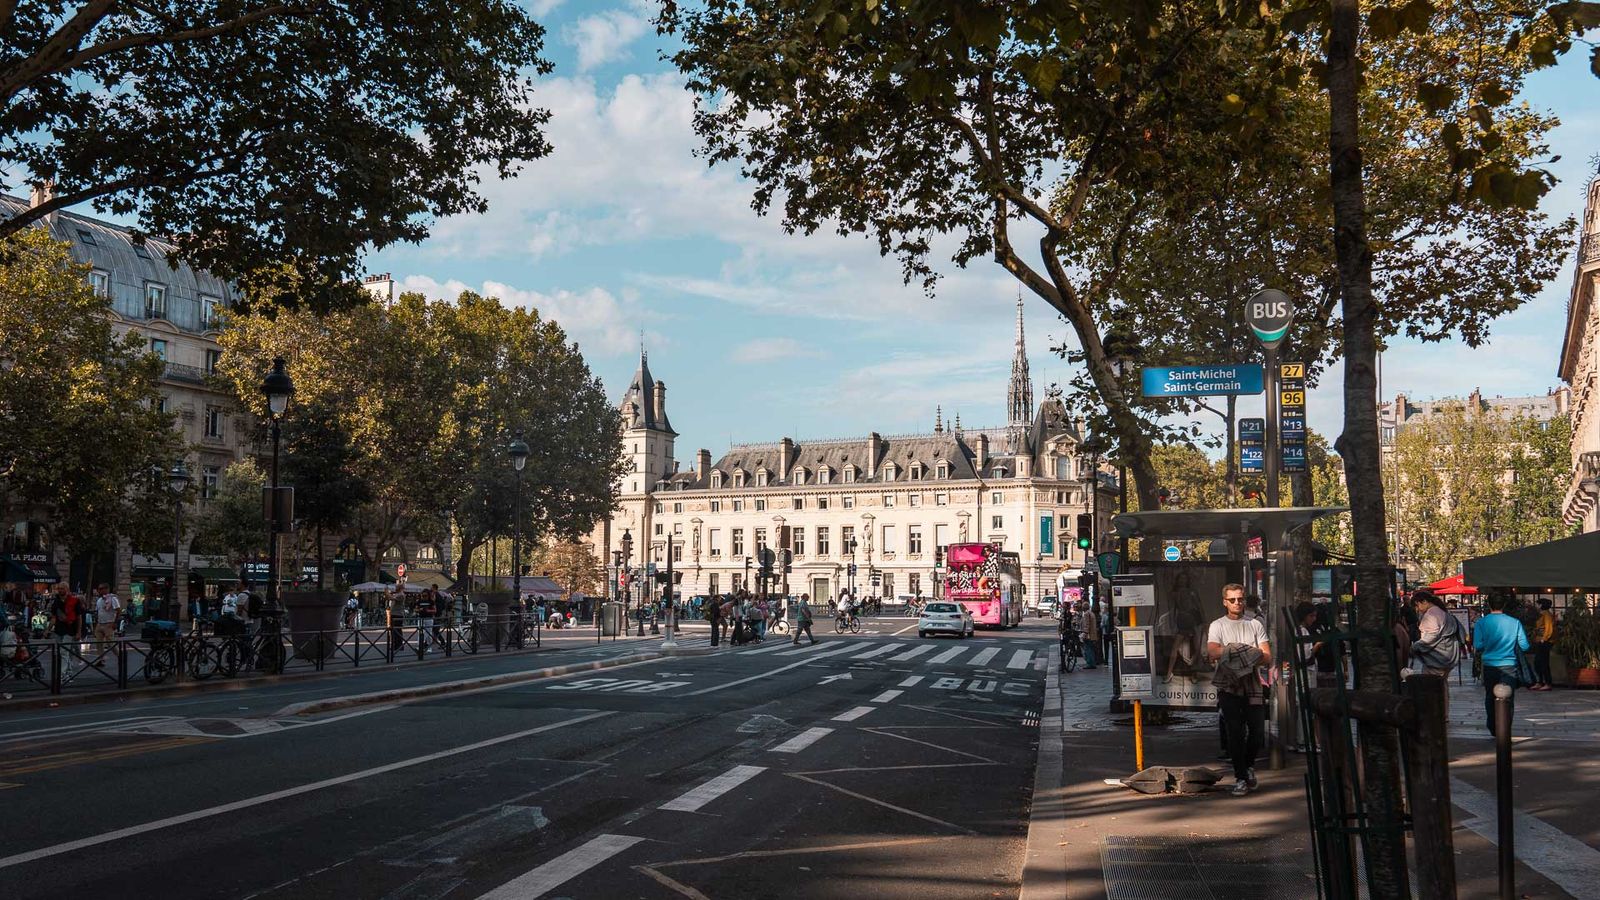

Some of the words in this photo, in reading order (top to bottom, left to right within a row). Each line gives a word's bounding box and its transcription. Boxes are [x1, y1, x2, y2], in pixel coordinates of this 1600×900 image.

[1253, 302, 1286, 319] BUS
[1168, 369, 1236, 381] Saint-Michel
[1283, 365, 1300, 377] 27
[1164, 381, 1241, 393] Saint-Germain
[1284, 392, 1301, 404] 96
[10, 553, 21, 561] LA
[23, 554, 47, 562] PLACE
[1156, 691, 1182, 699] OUIS
[1184, 691, 1219, 701] VUITTO
